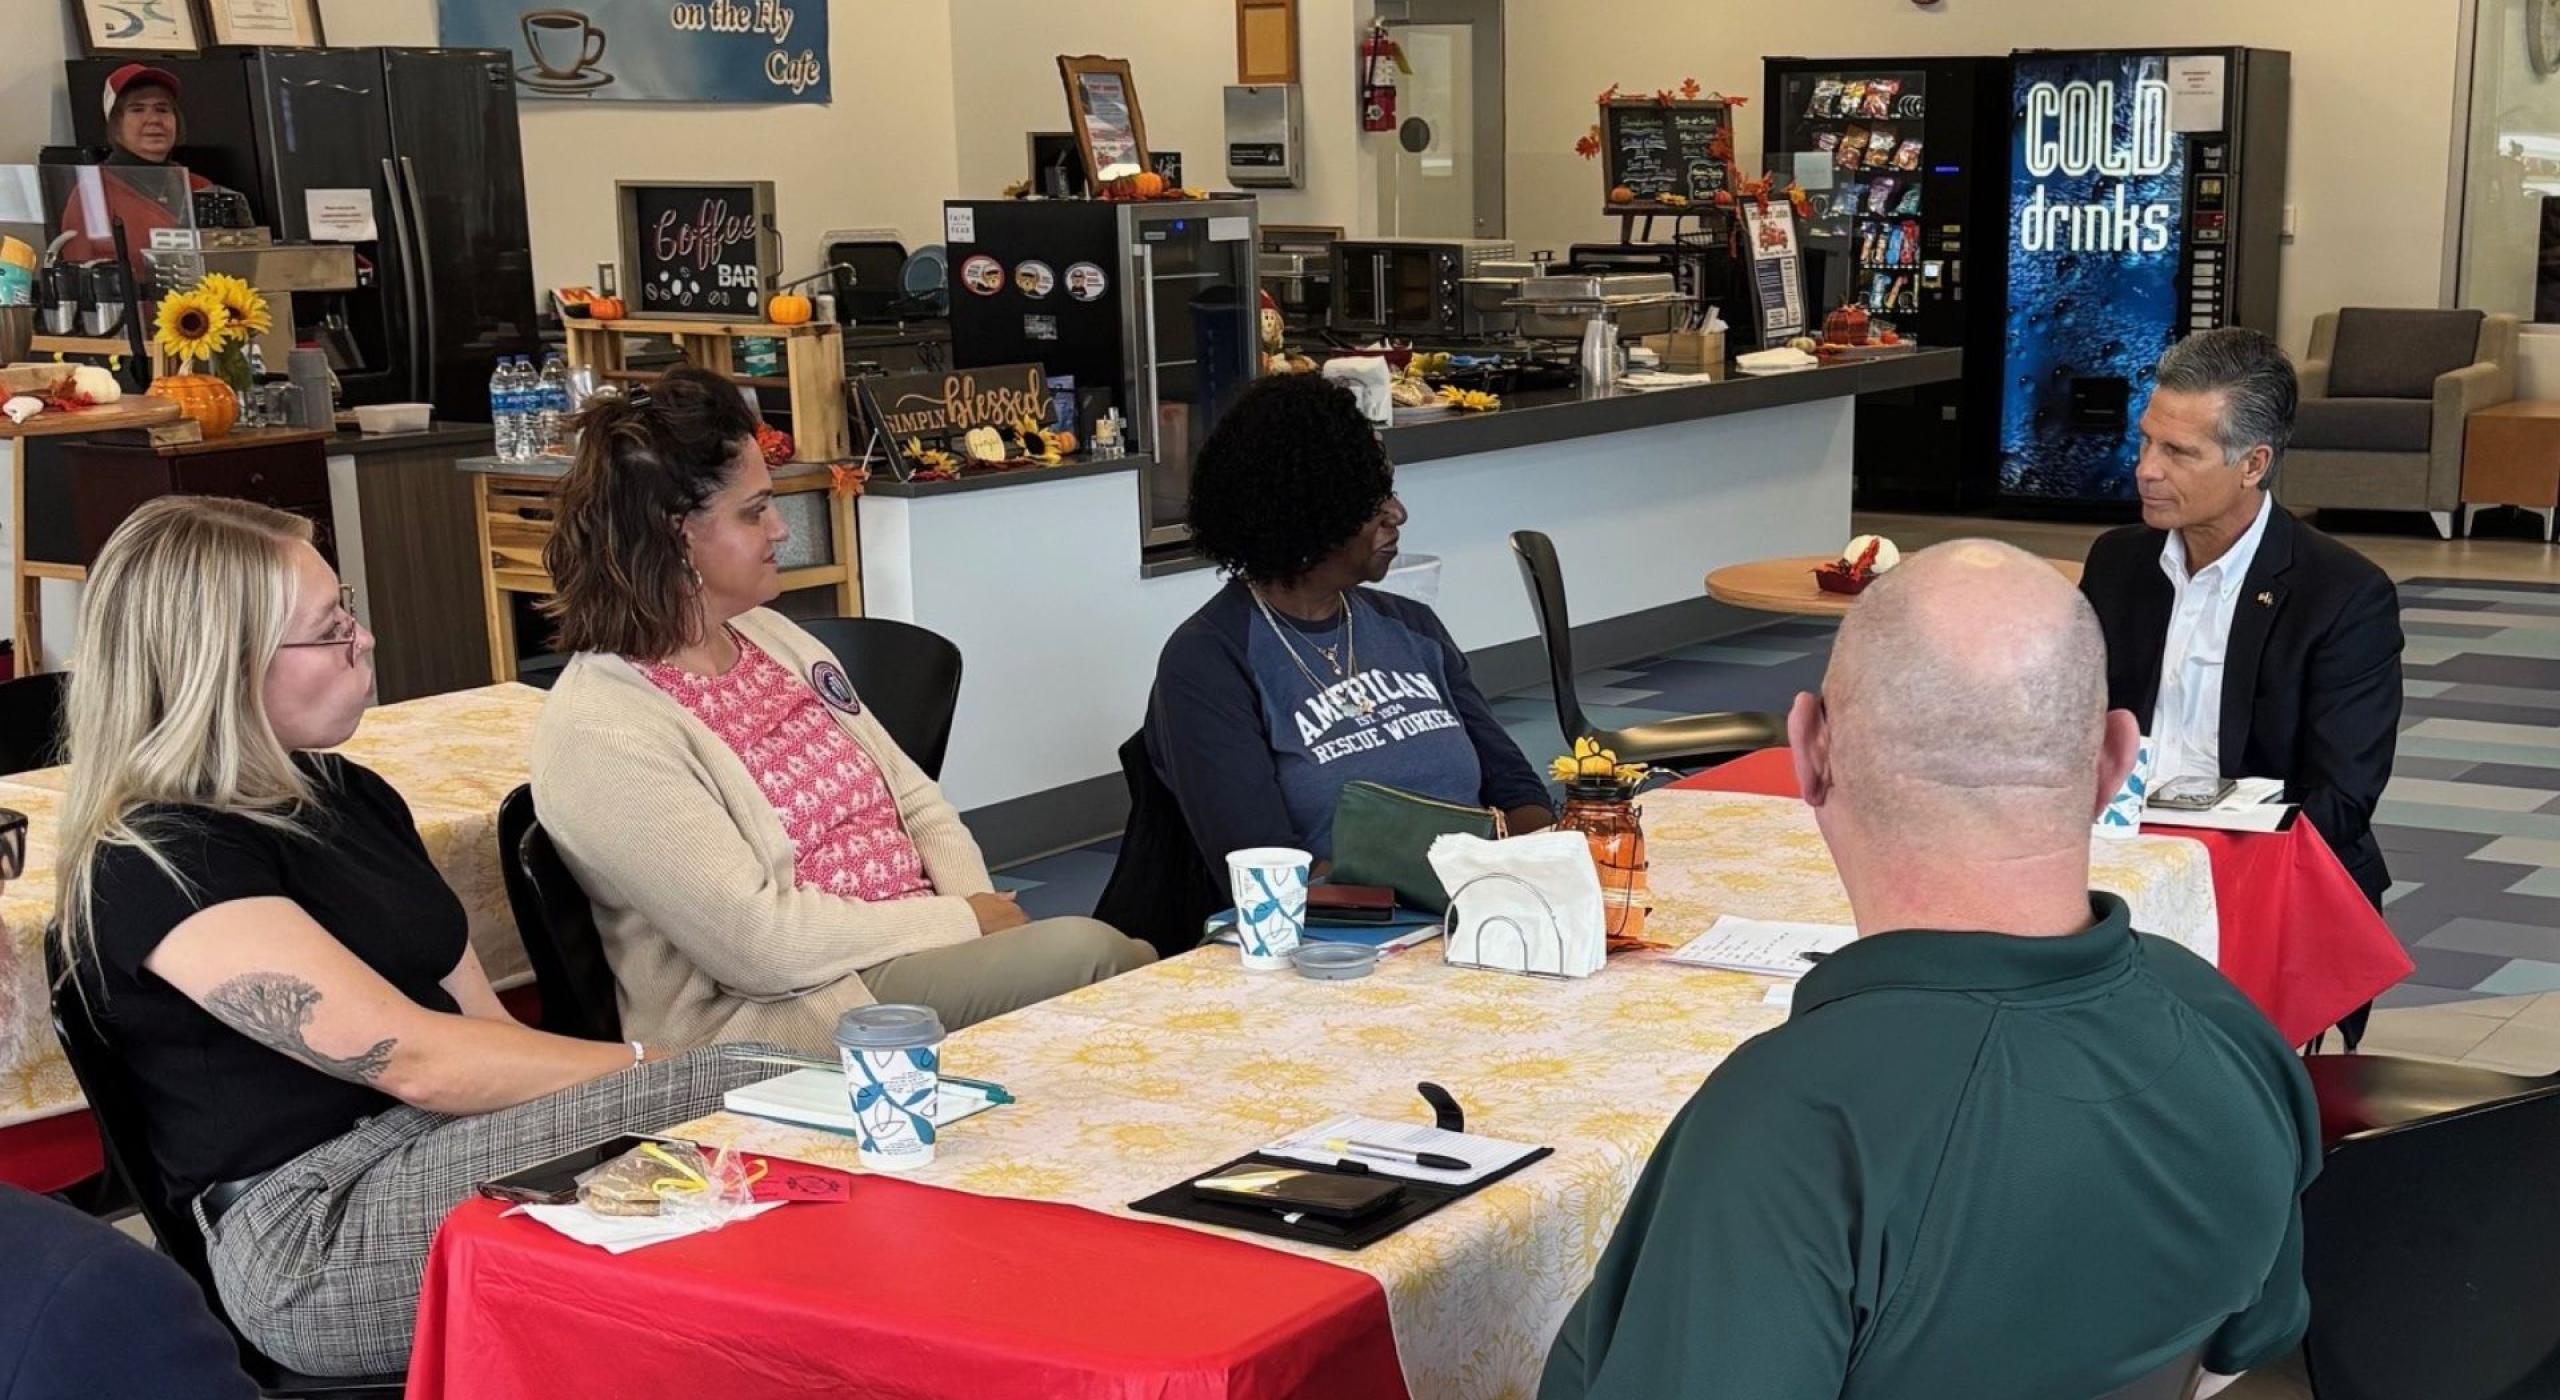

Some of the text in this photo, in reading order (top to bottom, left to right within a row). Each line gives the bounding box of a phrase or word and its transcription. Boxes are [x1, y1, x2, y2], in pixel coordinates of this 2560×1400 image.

[671, 0, 794, 44] on the Fly
[765, 49, 821, 95] Cafe
[2025, 79, 2173, 177] COLD
[652, 198, 756, 271] Coffee
[2021, 184, 2170, 251] drinks
[717, 264, 758, 288] BAR
[885, 368, 1053, 433] SIMPLY blessed
[1294, 668, 1443, 747] AMERICAN
[1311, 727, 1387, 765] RESCUE
